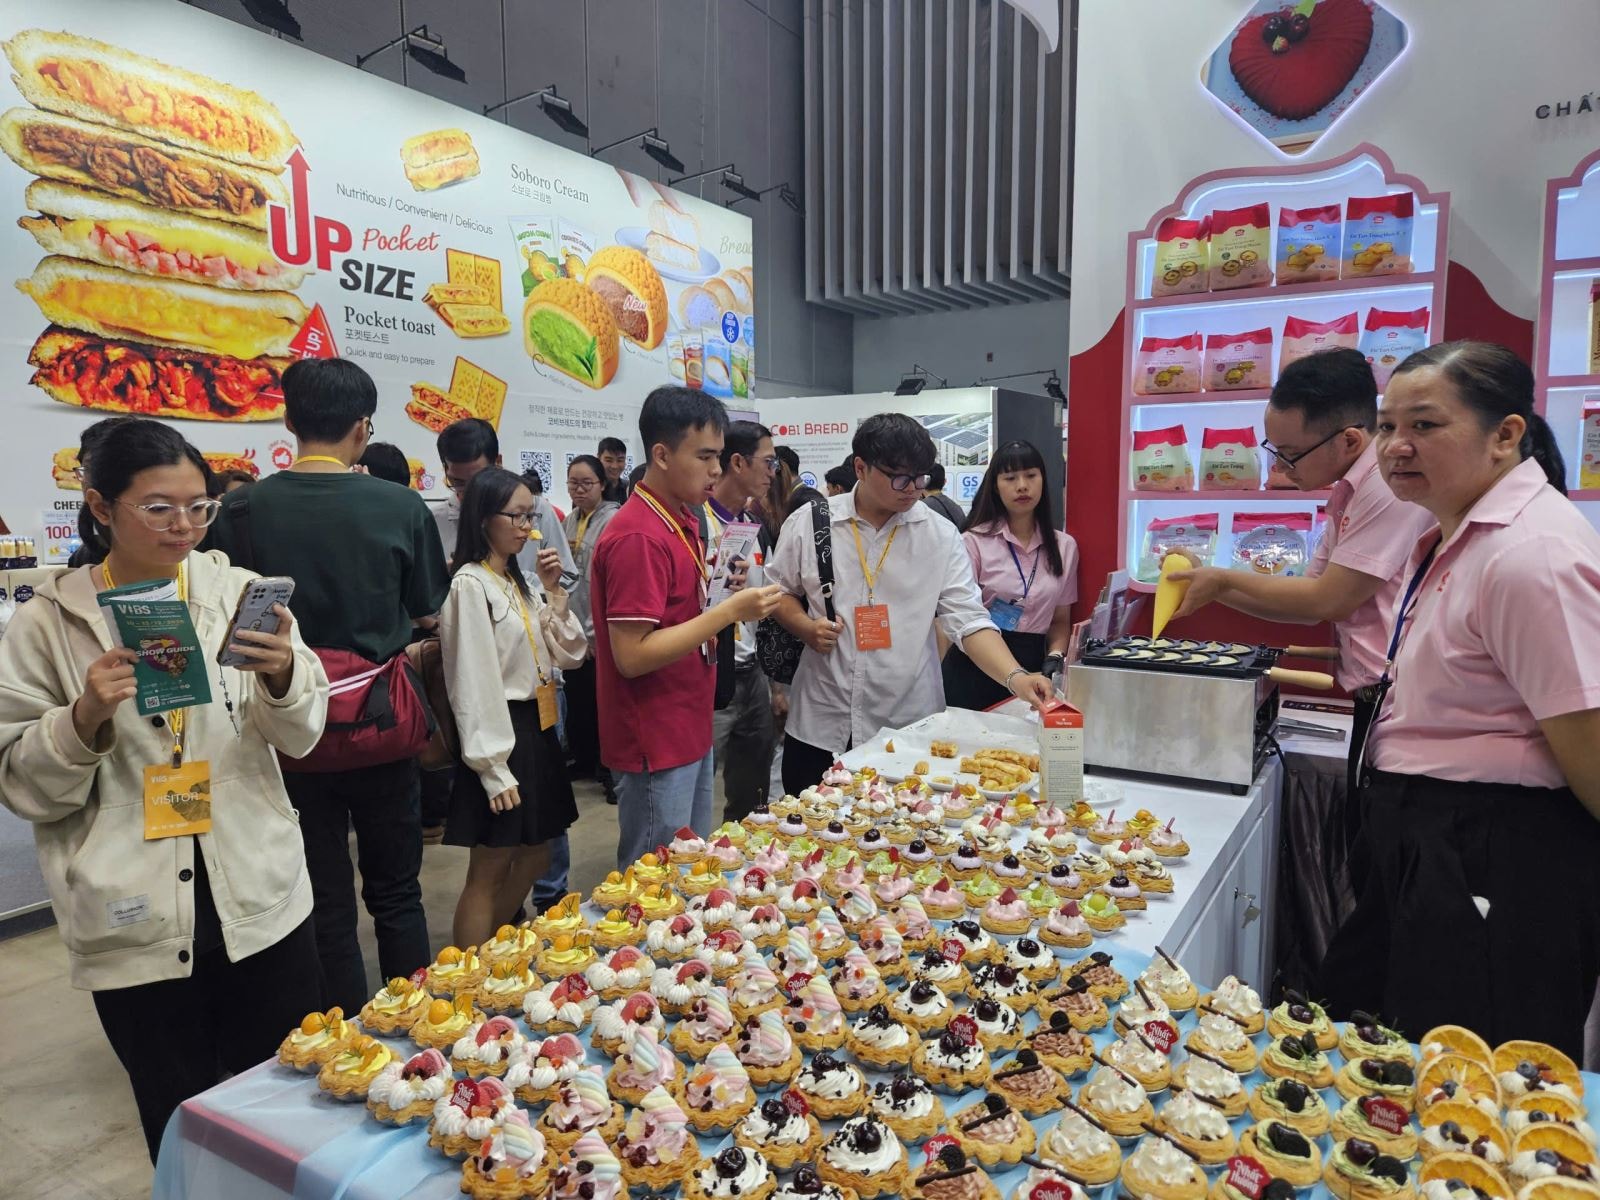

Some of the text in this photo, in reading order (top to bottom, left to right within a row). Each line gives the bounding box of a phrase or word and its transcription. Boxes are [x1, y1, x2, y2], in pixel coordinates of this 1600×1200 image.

[1535, 91, 1600, 119] CHẤ
[511, 163, 589, 204] Soboro Cream
[511, 184, 532, 199] 소보로
[336, 183, 387, 208] Nutritious
[395, 198, 448, 224] Convenient
[455, 215, 494, 235] Delicious
[362, 224, 441, 252] Pocket
[339, 258, 416, 301] SIZE
[622, 294, 648, 312] New
[344, 306, 436, 336] Pocket toast
[345, 327, 390, 344] 포켓토스트
[345, 346, 436, 366] Quick and easy to prepare
[804, 421, 849, 436] BREAD
[962, 476, 978, 487] GS
[54, 500, 82, 510] CHEE
[117, 604, 151, 615] VIBS
[136, 645, 196, 657] SHOW GUIDE
[152, 791, 199, 805] VISITOR
[1150, 1023, 1172, 1040] Nhất
[1371, 1104, 1401, 1121] Nhất
[1234, 1159, 1264, 1184] Nhất
